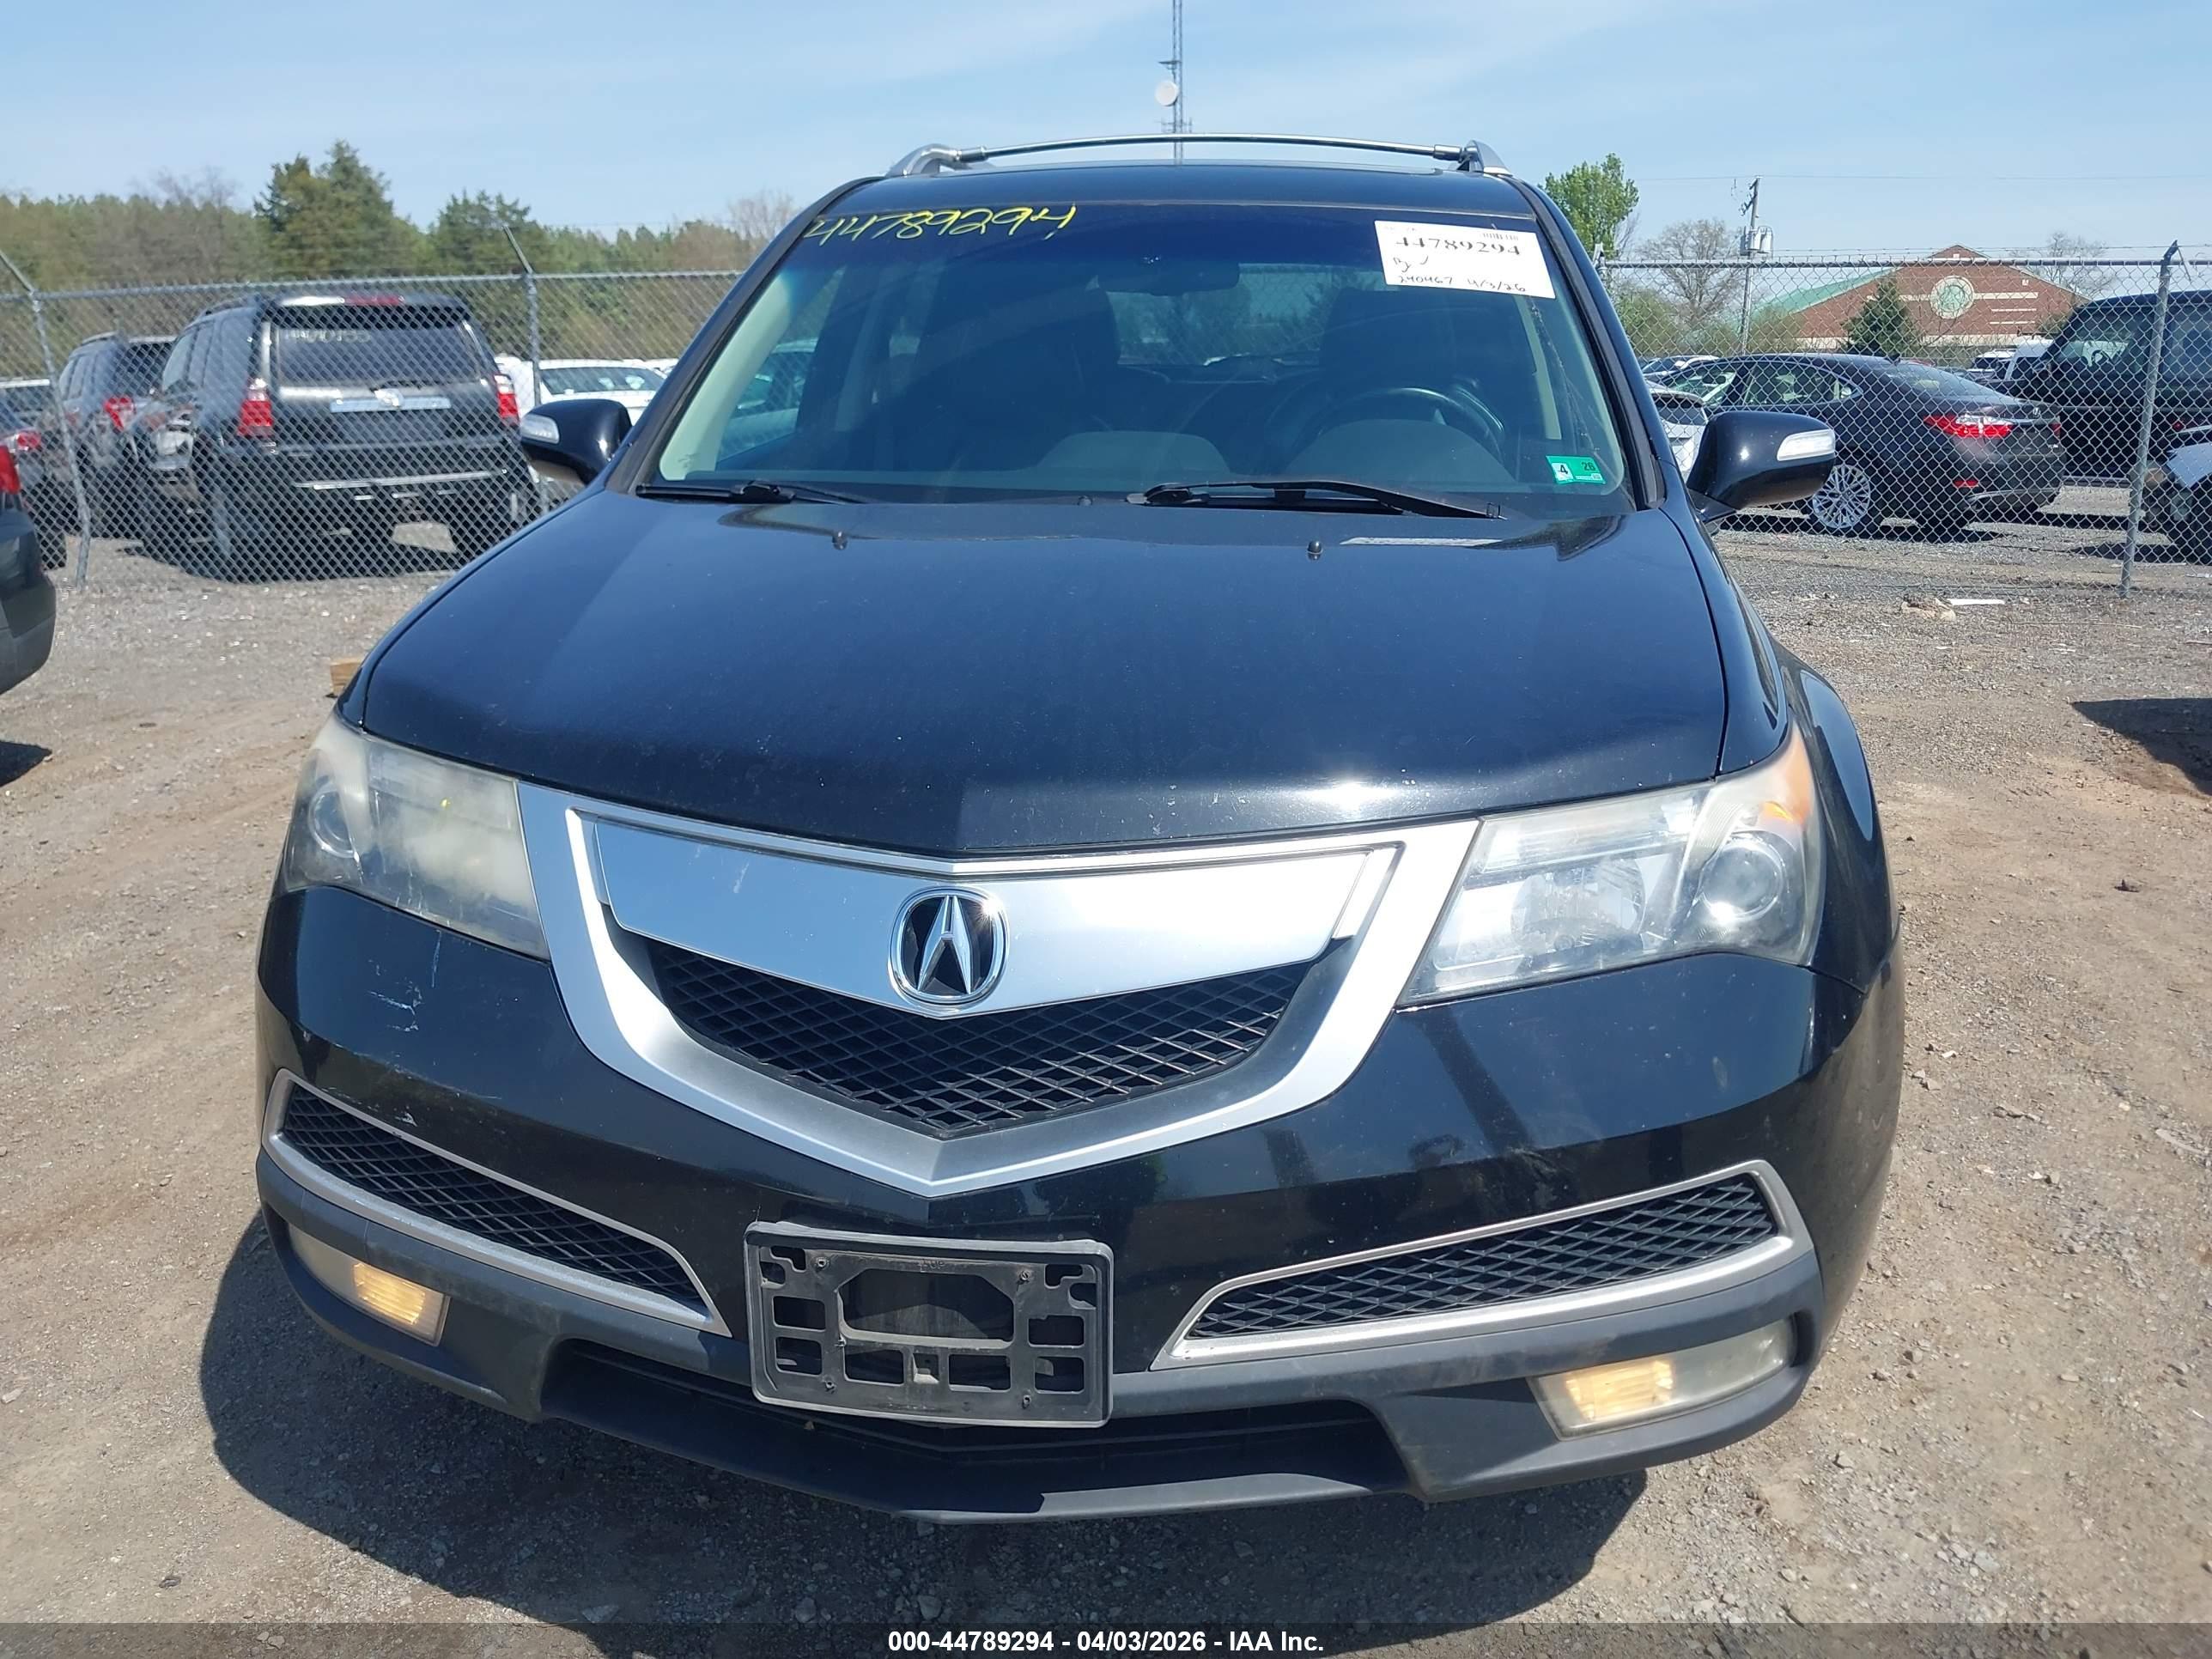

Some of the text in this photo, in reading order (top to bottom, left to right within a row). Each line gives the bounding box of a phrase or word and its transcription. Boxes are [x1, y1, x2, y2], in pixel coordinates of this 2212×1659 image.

[804, 204, 1076, 246] 44789294
[1396, 236, 1520, 256] 44789294
[1559, 465, 1568, 474] 4
